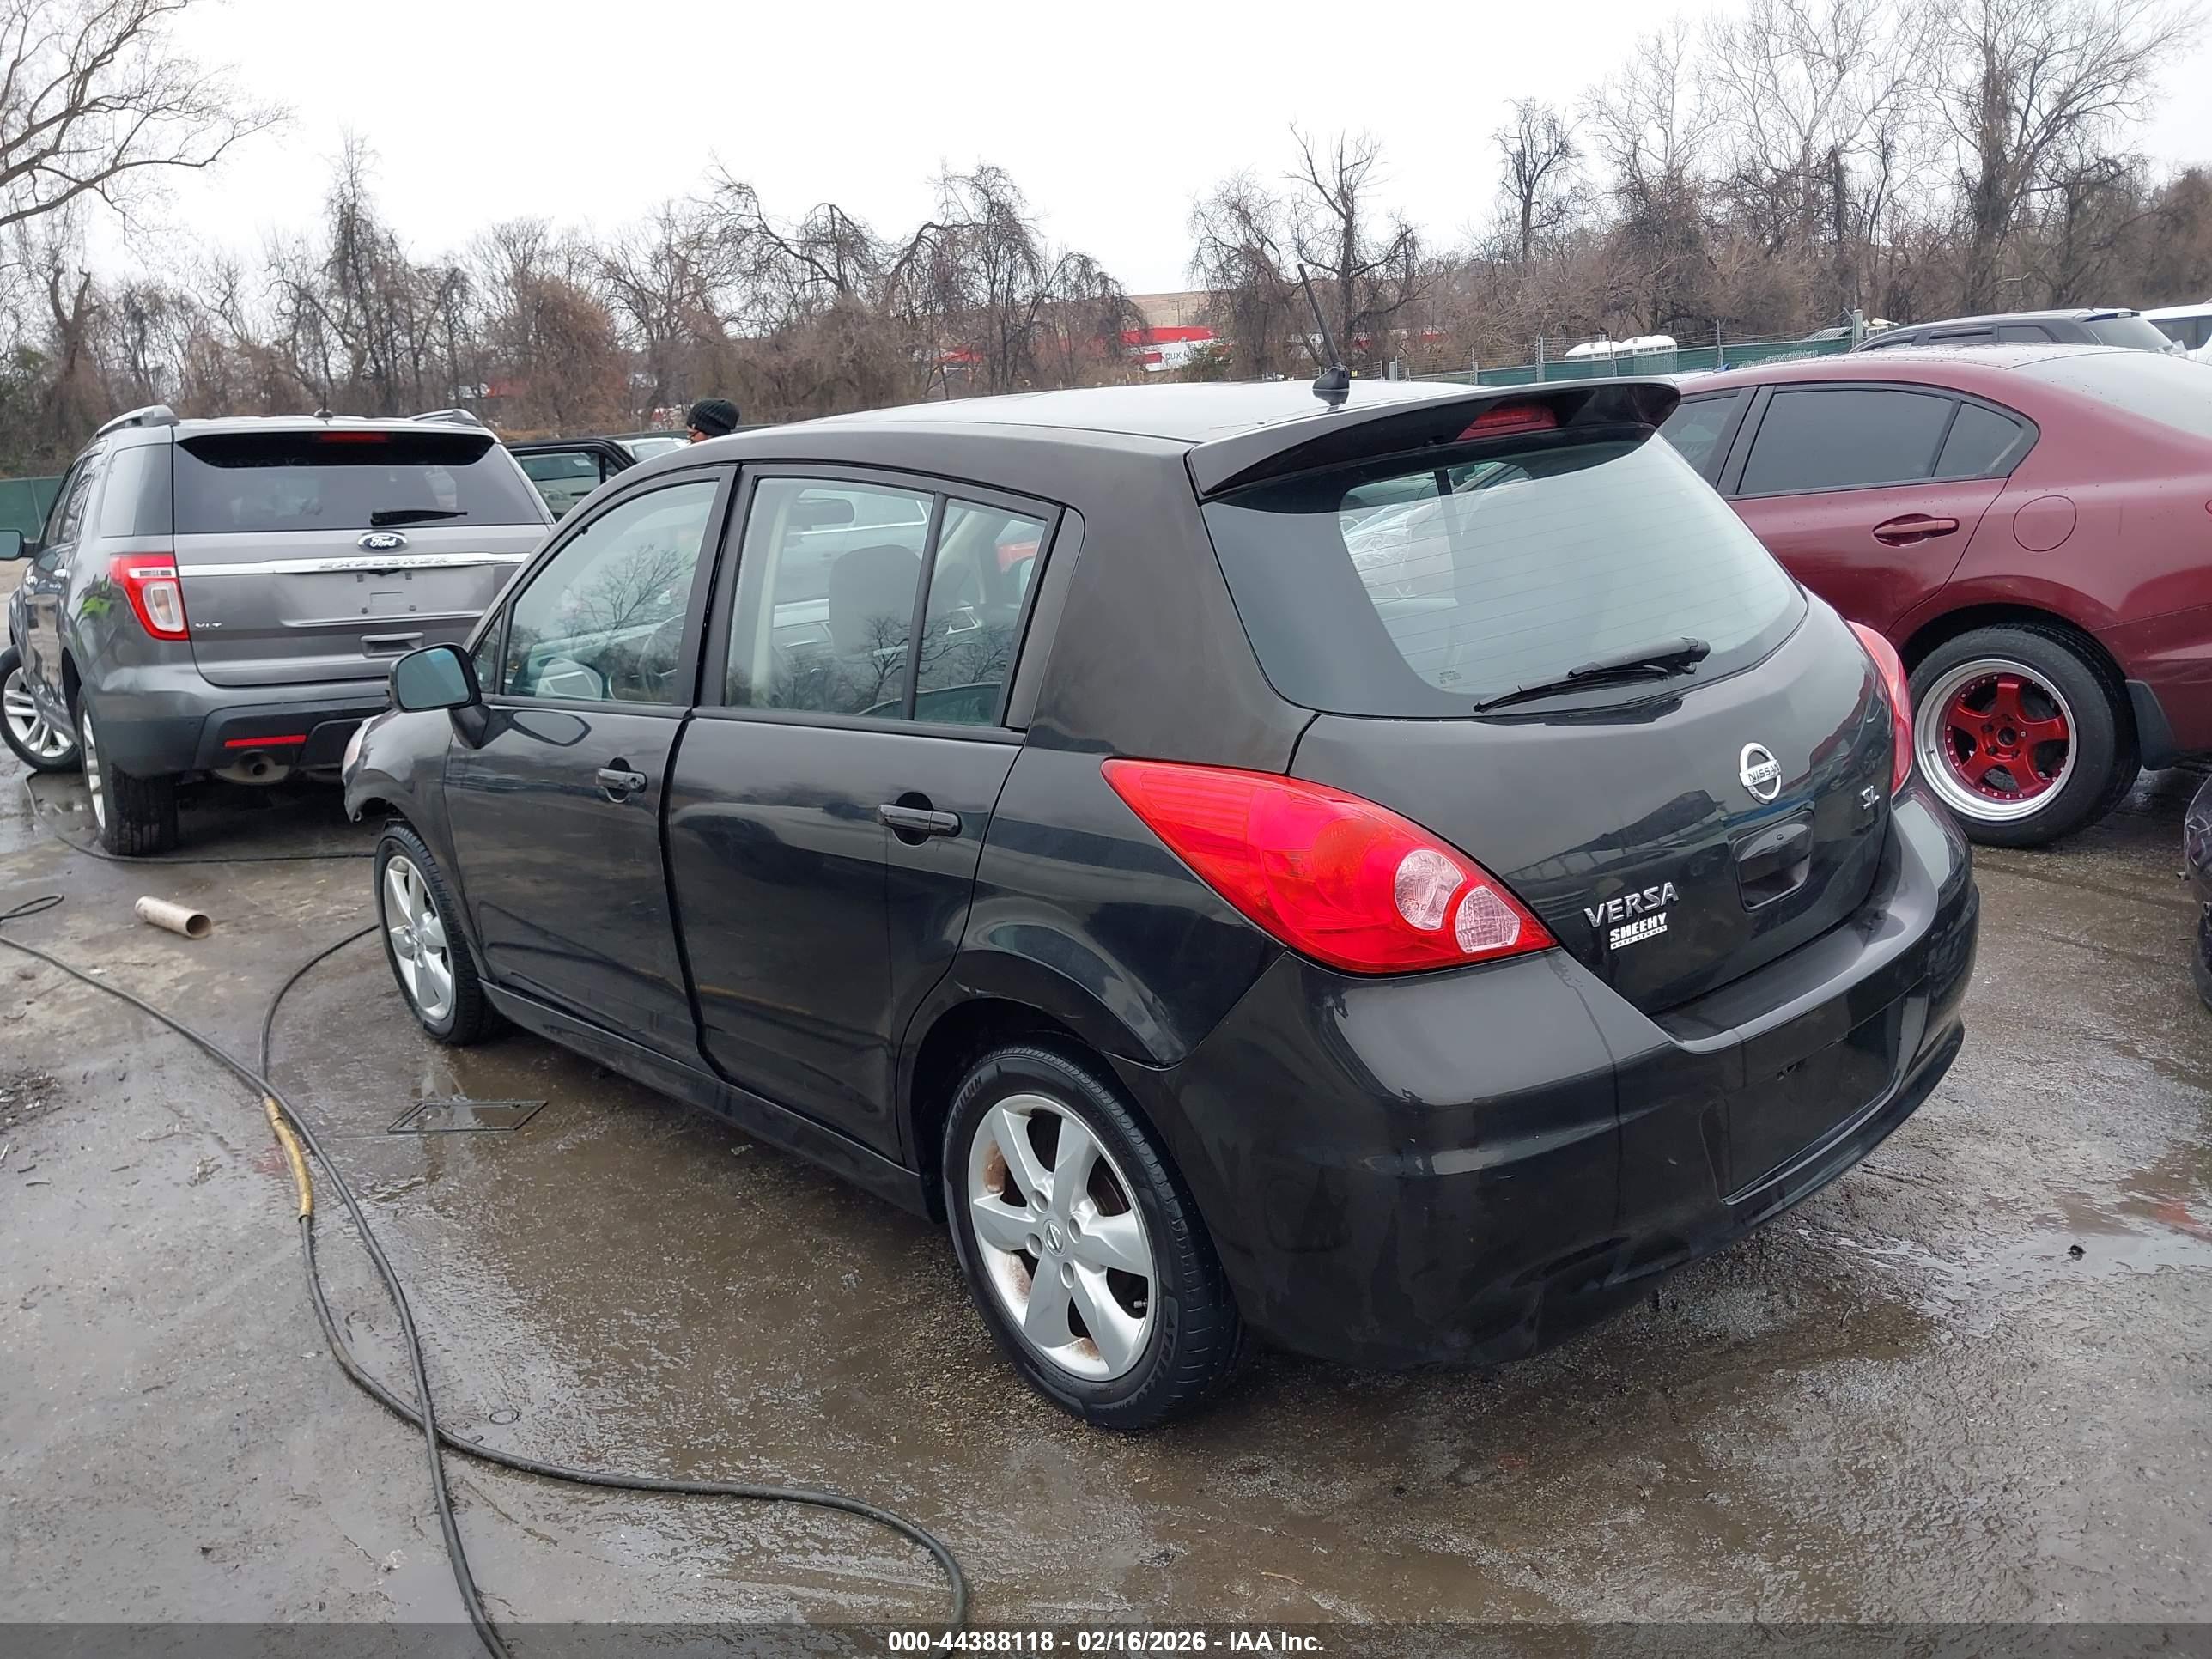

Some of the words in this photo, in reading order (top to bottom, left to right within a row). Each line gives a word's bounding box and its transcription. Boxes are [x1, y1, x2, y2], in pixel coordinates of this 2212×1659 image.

[1747, 763, 1780, 783] NISSAN
[1583, 882, 1680, 927] VERSA
[1609, 912, 1667, 942] SHEEHY
